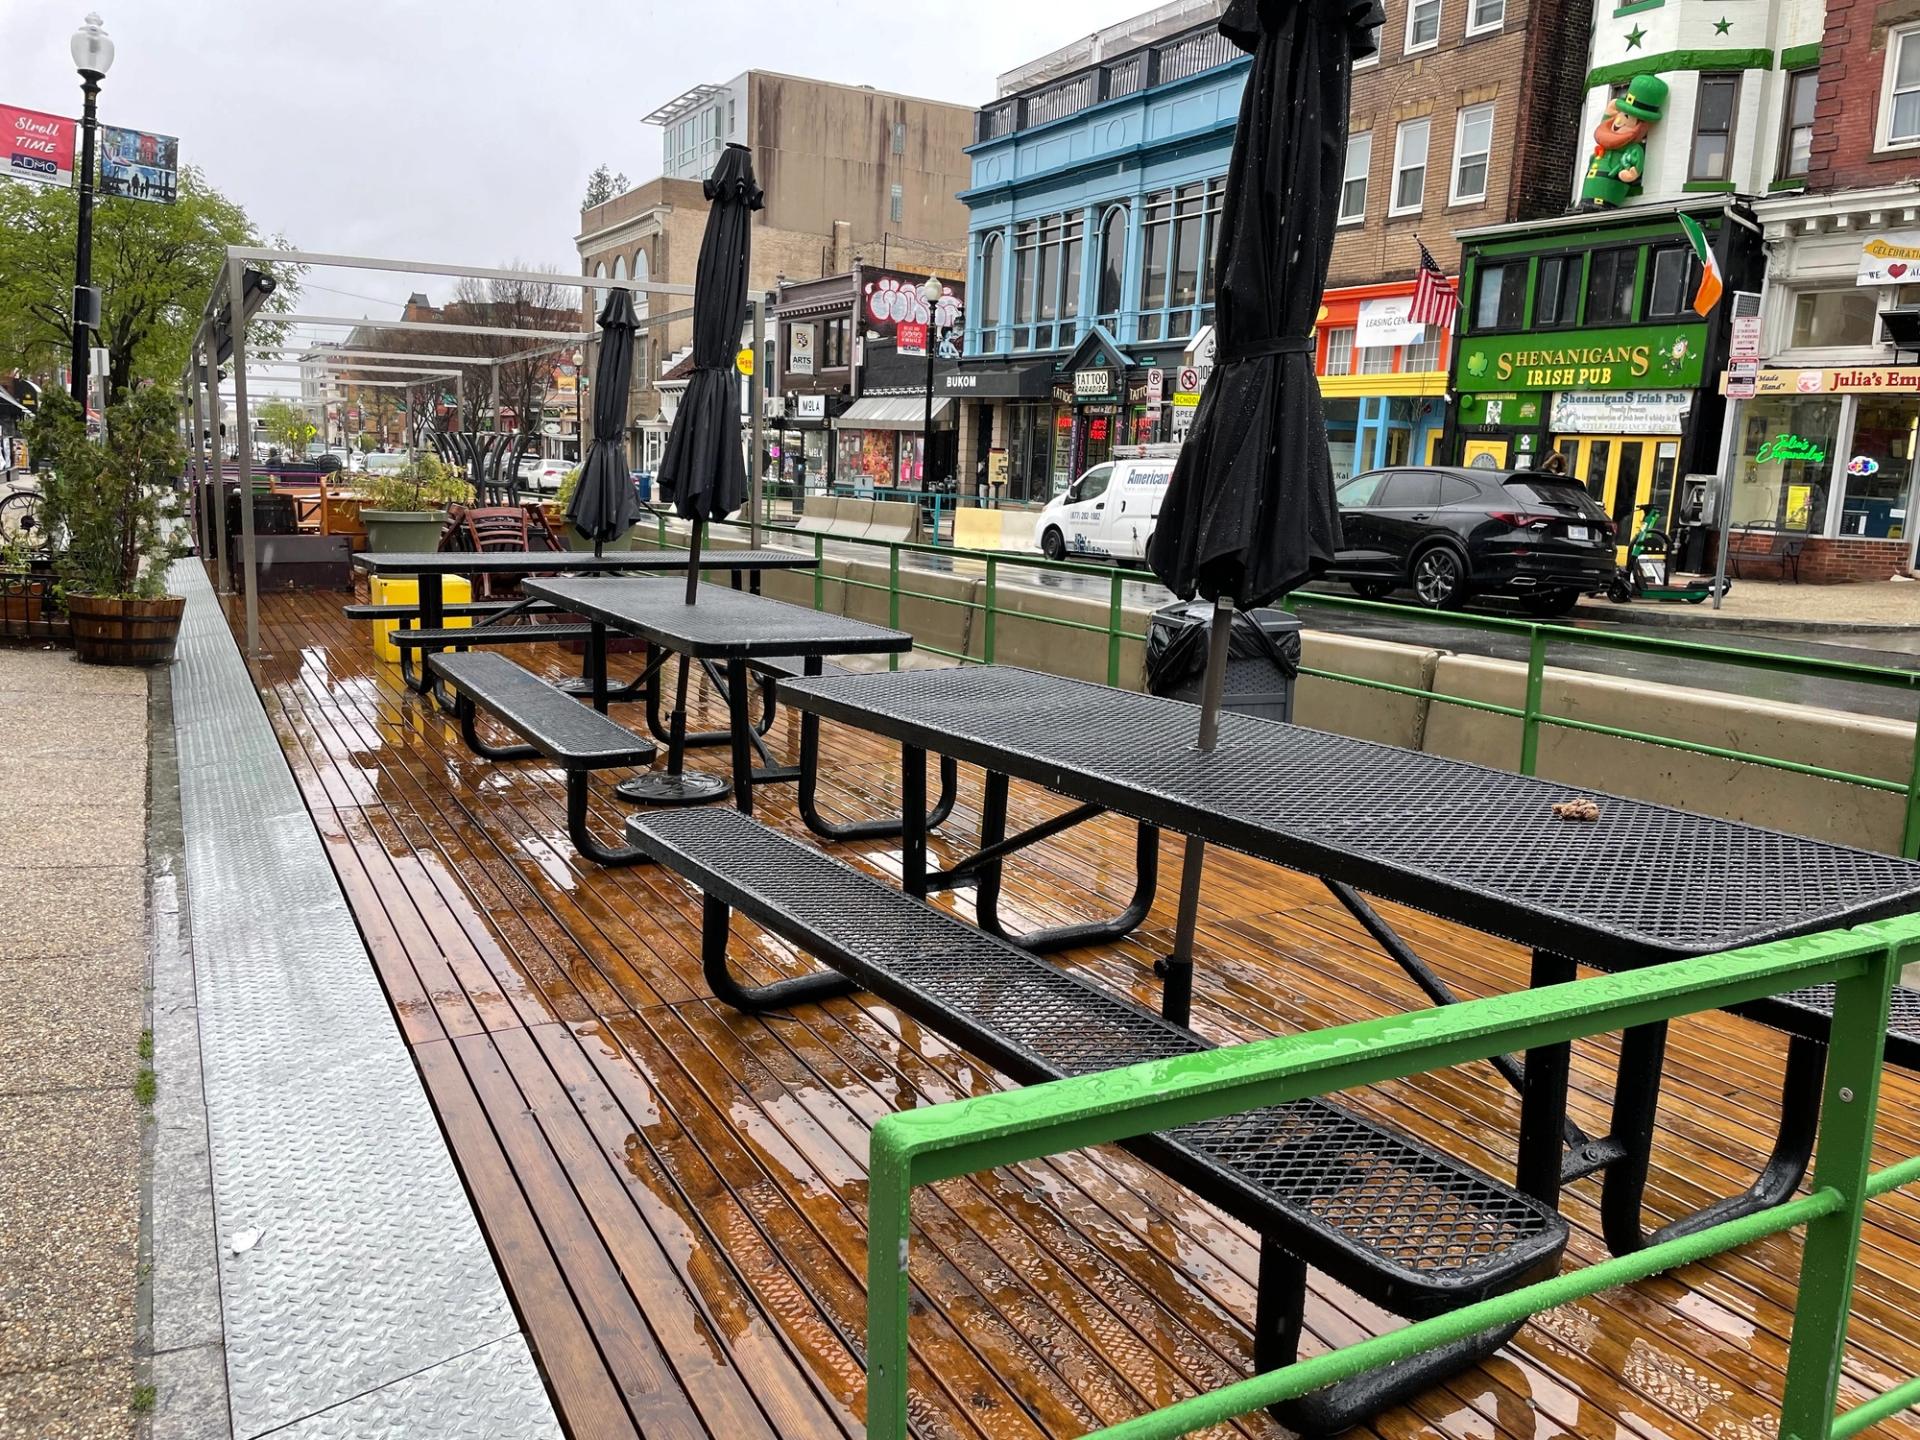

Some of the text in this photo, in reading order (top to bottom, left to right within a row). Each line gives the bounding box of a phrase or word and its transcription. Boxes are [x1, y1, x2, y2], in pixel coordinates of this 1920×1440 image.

[15, 117, 60, 136] Stroll
[15, 136, 56, 153] TIME
[1868, 270, 1881, 279] WE
[1365, 316, 1408, 328] LEASING CEN
[792, 356, 812, 365] ARTS
[1496, 345, 1650, 381] SHENANIGANS
[946, 375, 977, 388] BUKOM
[1076, 373, 1108, 386] TATTOO
[1526, 368, 1611, 386] IRISH PUB
[1830, 371, 1882, 391] Julia's
[1077, 385, 1107, 393] PARADISE
[1129, 385, 1148, 401] TATTO
[1637, 393, 1662, 404] Irish
[1665, 393, 1686, 403] Pub
[1175, 410, 1193, 418] SPEE
[1127, 469, 1169, 485] American
